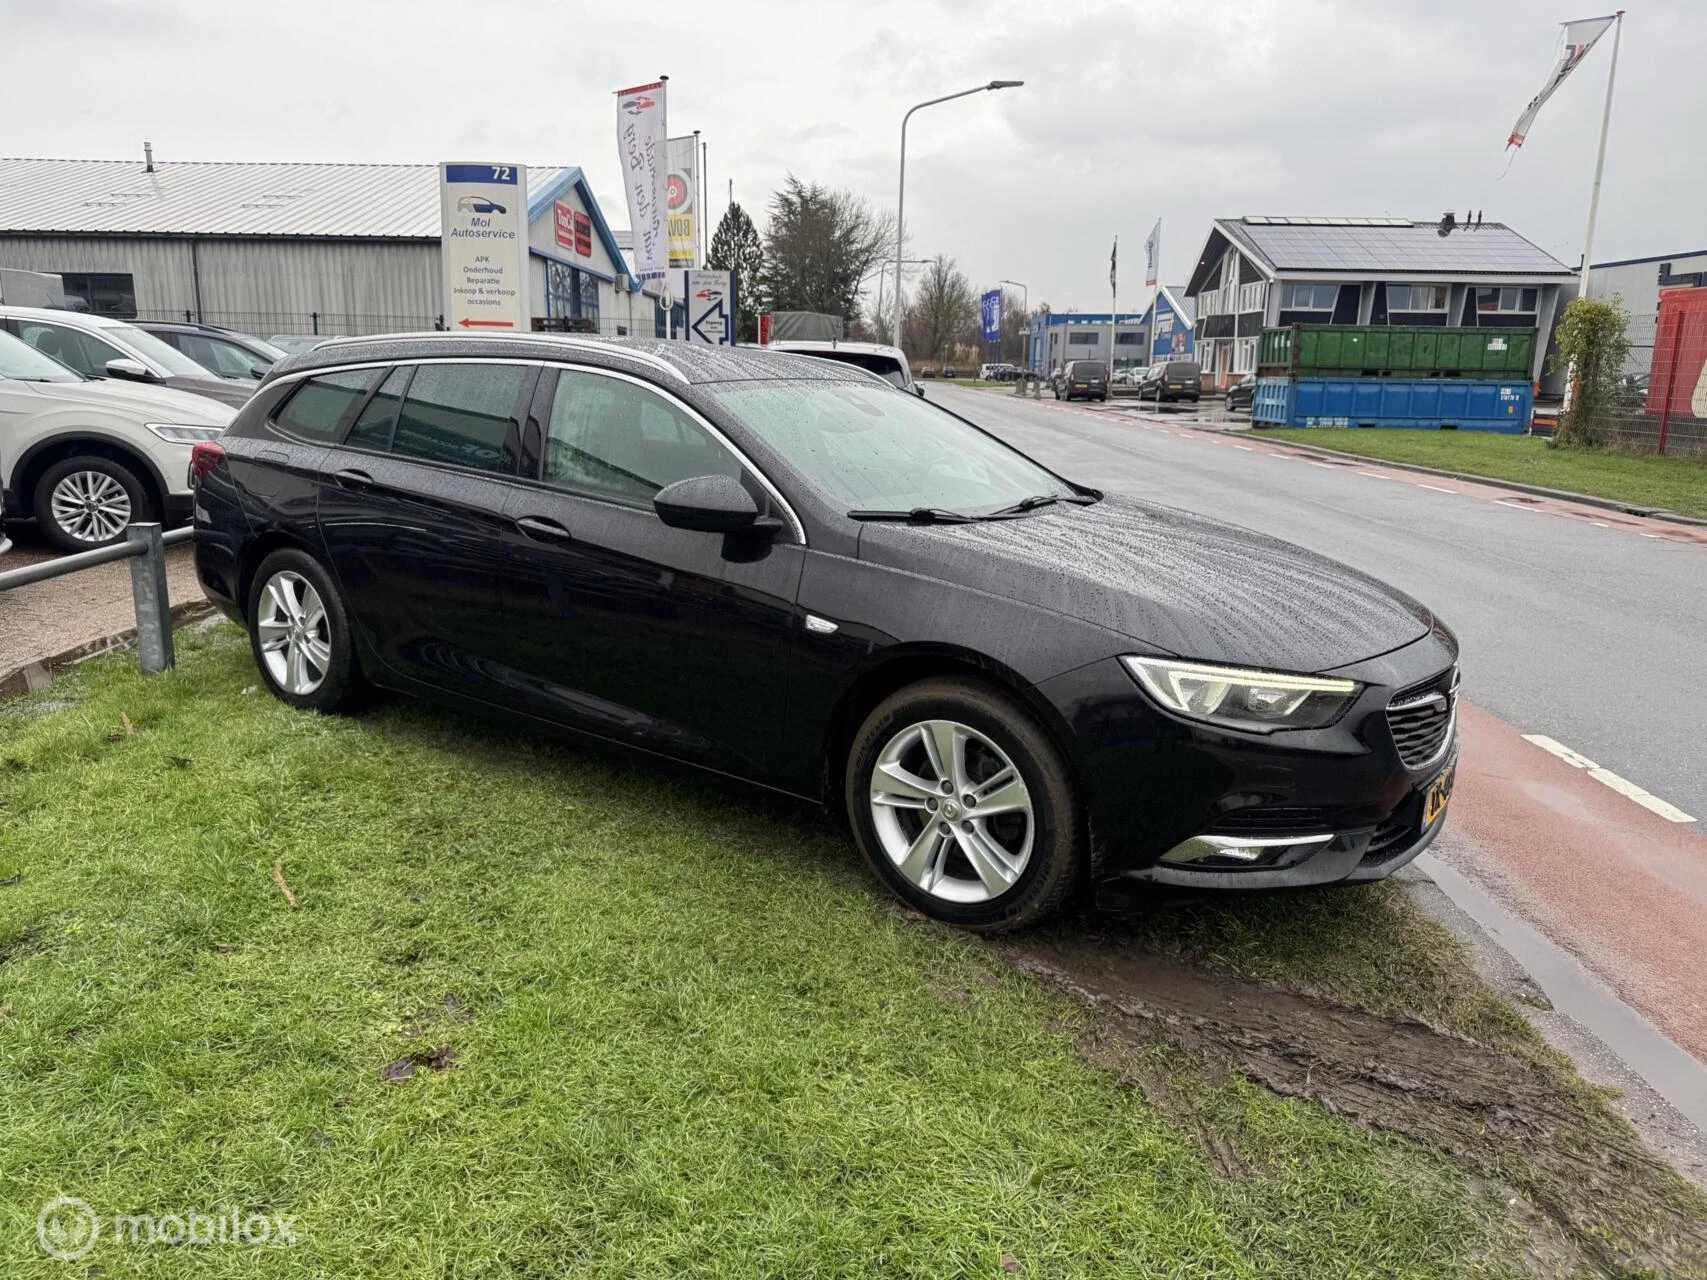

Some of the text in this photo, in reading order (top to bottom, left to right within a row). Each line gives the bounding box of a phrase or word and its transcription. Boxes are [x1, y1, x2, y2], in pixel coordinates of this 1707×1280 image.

[492, 166, 511, 180] 72
[471, 217, 491, 227] Mol
[451, 228, 516, 239] Autoservice
[463, 266, 504, 274] Onderhoud
[466, 276, 500, 285] Reparatie
[453, 287, 516, 297] Inkoop & verkoop
